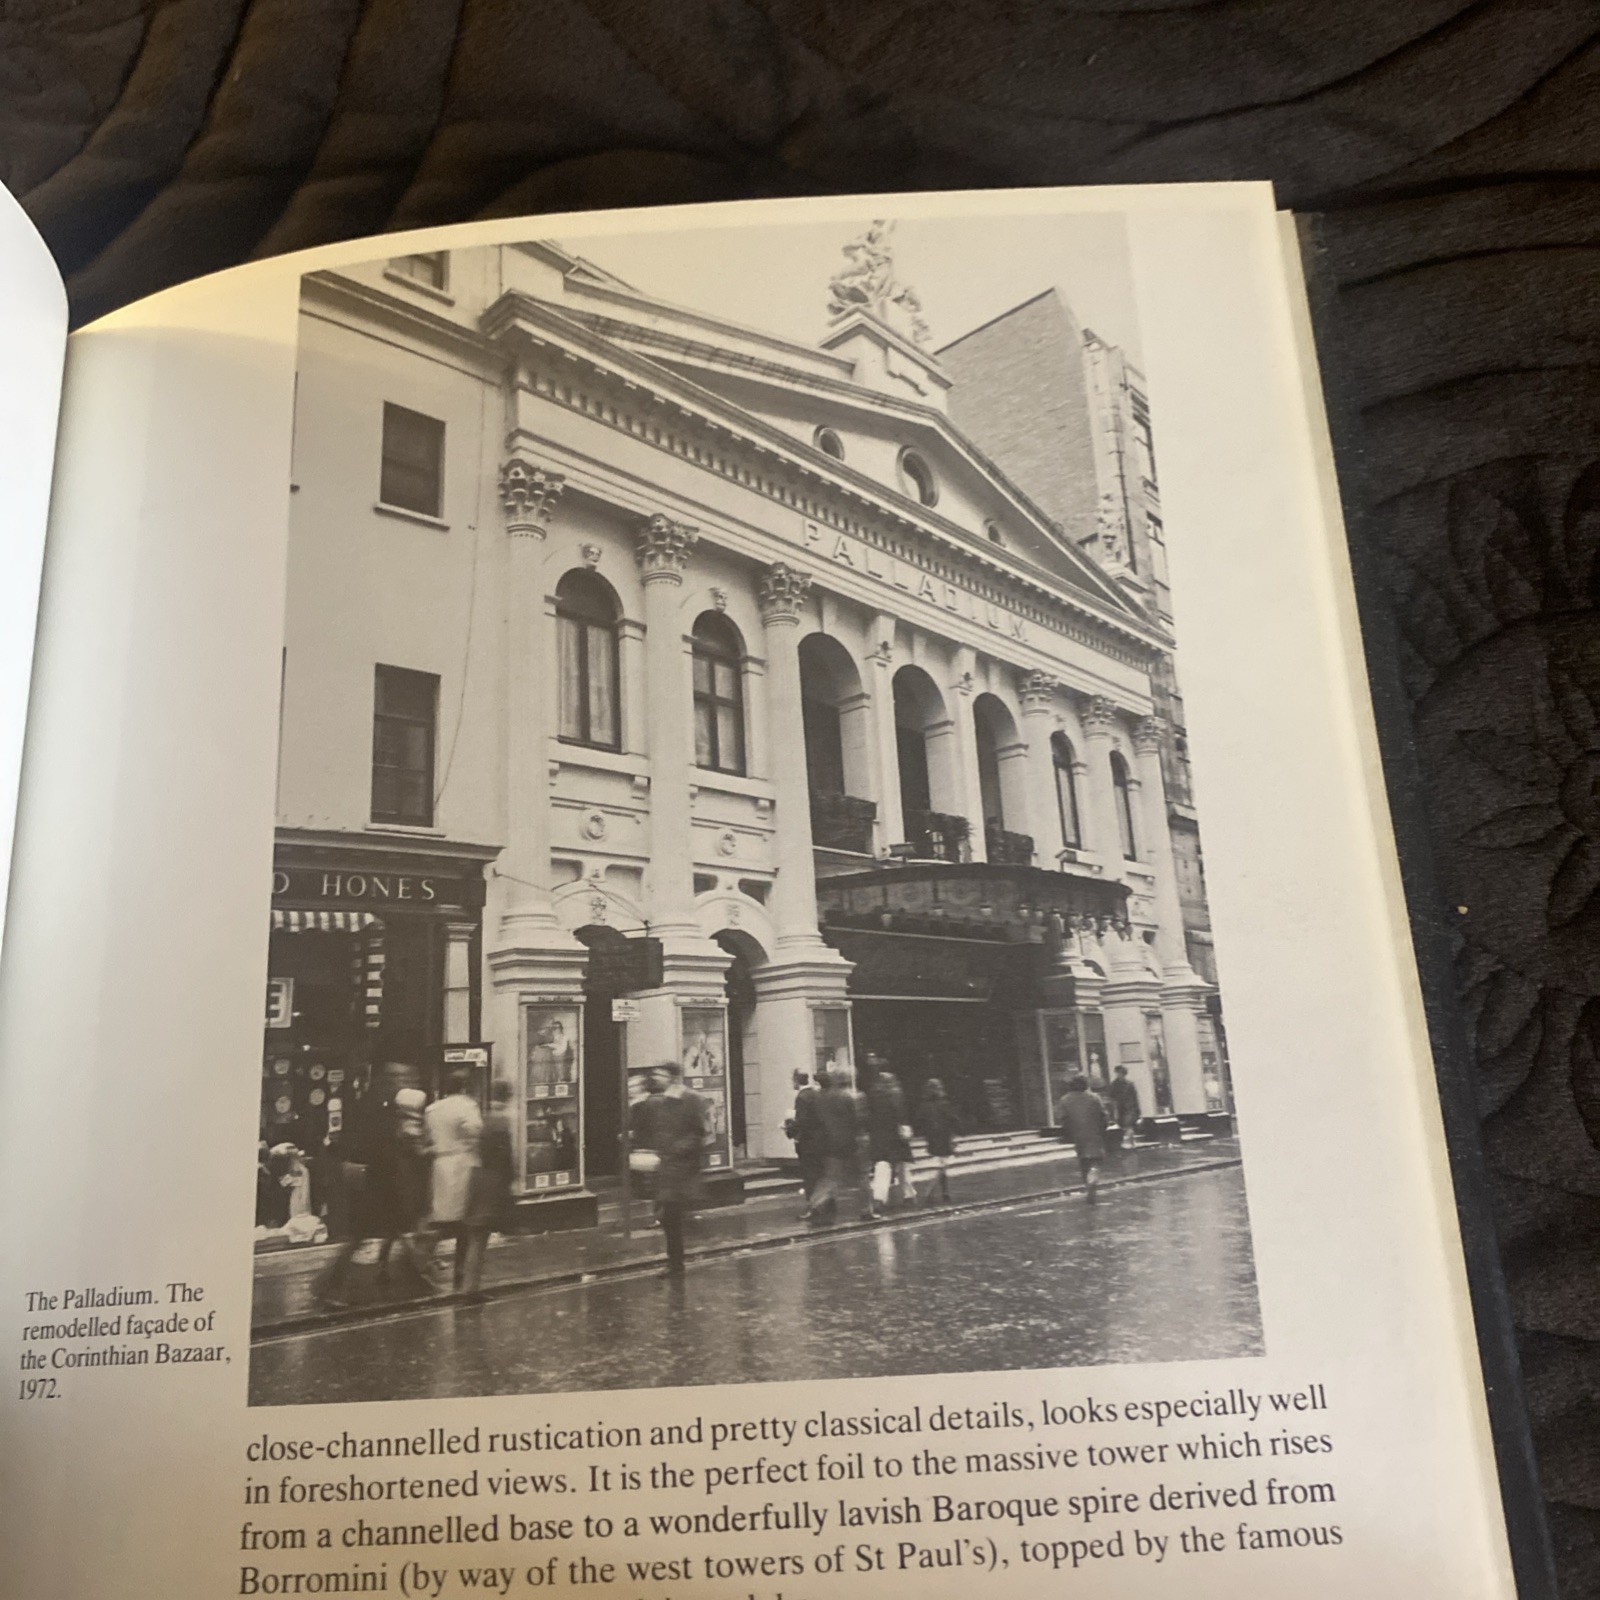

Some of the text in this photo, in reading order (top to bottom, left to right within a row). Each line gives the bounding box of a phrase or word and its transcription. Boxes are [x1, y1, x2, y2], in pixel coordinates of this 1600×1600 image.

[803, 518, 1029, 643] PALLADIUM
[321, 873, 436, 900] HONES
[25, 1283, 204, 1312] The Palladium. The
[23, 1310, 216, 1341] remodelled façade of
[20, 1343, 231, 1370] the Corinthian Bazaar,
[19, 1378, 61, 1400] 1972.
[246, 1383, 1328, 1462] close-channelled rustication and pretty classical details, looks especially well
[245, 1429, 1333, 1504] in foreshortened views. It is the perfect foil to the massive tower which rises
[240, 1478, 1336, 1550] from a channelled base to a wonderfully lavish Baroque spire derived from
[239, 1563, 387, 1595] Borromini
[399, 1561, 448, 1598] (by
[458, 1568, 516, 1596] way
[526, 1557, 558, 1586] of
[569, 1556, 615, 1585] the
[626, 1557, 693, 1581] west
[704, 1555, 804, 1578] towers
[814, 1544, 845, 1573] of
[855, 1544, 885, 1572] St
[1020, 1530, 1125, 1569] topped
[1134, 1529, 1169, 1563] by
[1180, 1526, 1226, 1553] the
[1236, 1522, 1343, 1550] famous
